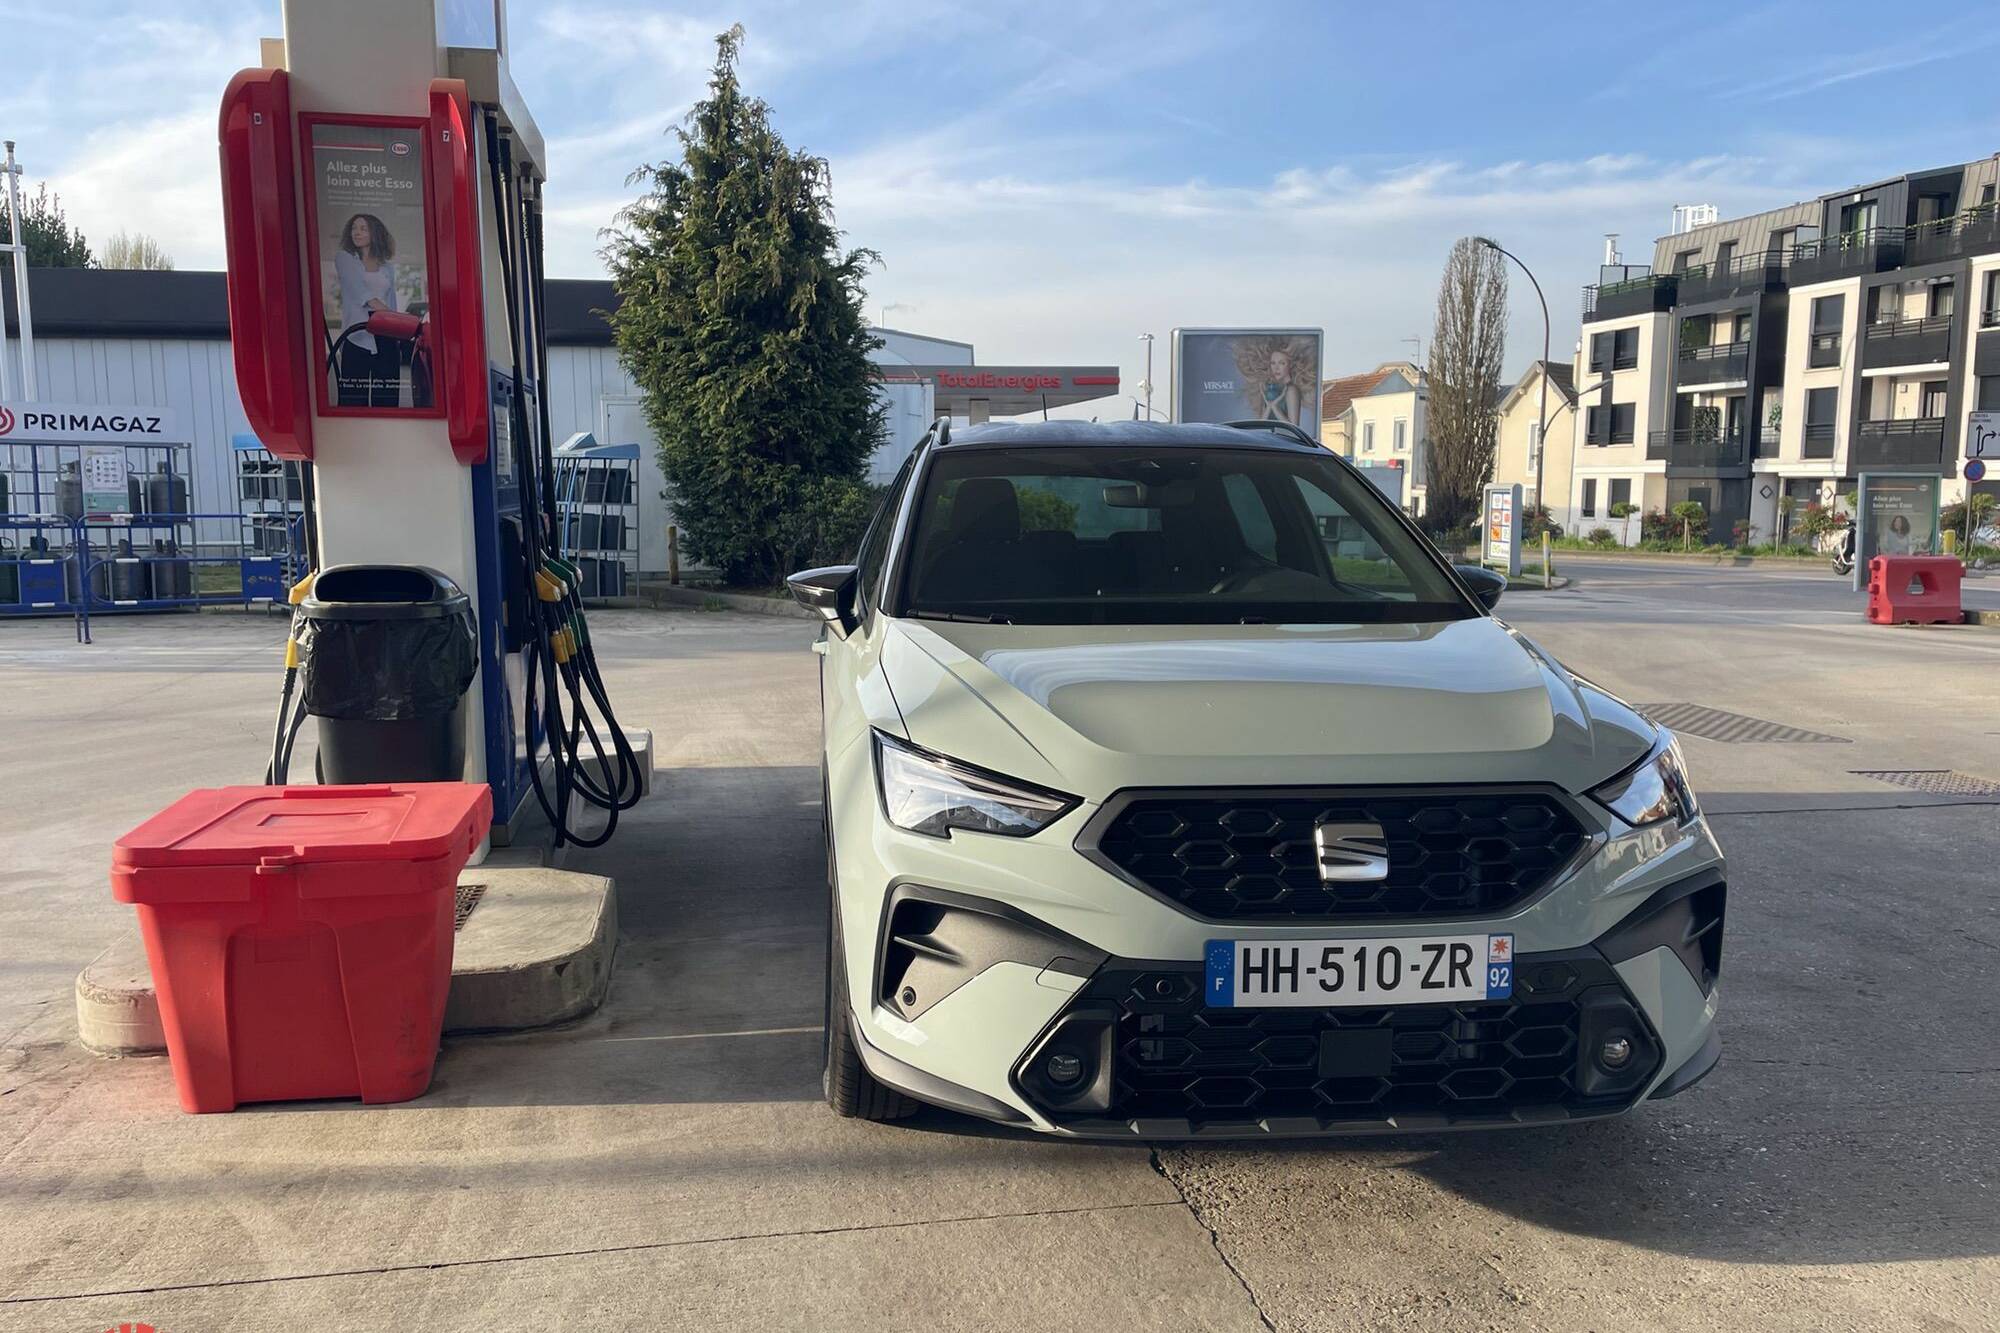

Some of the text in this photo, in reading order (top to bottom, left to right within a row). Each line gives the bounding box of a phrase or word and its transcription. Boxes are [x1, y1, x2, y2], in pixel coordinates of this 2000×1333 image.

[327, 161, 387, 176] Allez plus
[327, 175, 413, 189] loin avec Esso
[937, 372, 1062, 392] TotalEnergies
[23, 412, 162, 434] PRIMAGAZ
[1215, 942, 1474, 994] F HH-510-ZR
[1490, 967, 1509, 988] 92
